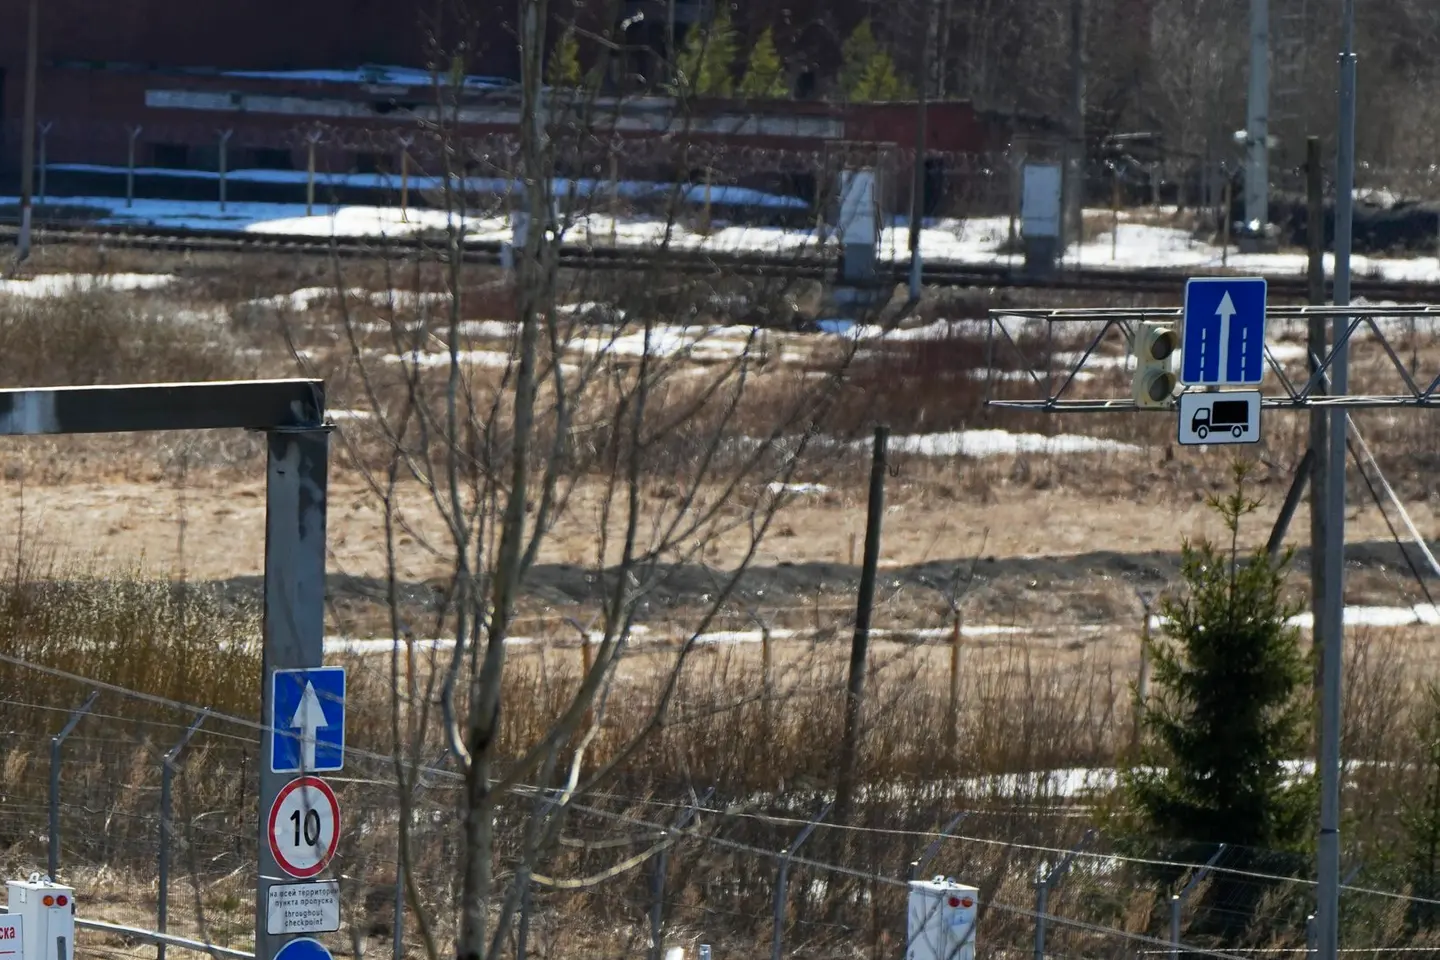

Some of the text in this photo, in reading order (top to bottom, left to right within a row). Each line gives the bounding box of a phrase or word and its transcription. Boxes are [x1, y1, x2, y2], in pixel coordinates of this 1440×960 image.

[290, 808, 321, 847] 10
[274, 898, 334, 908] пункта пропуска
[285, 910, 323, 918] throughout
[285, 919, 323, 927] checkpoint
